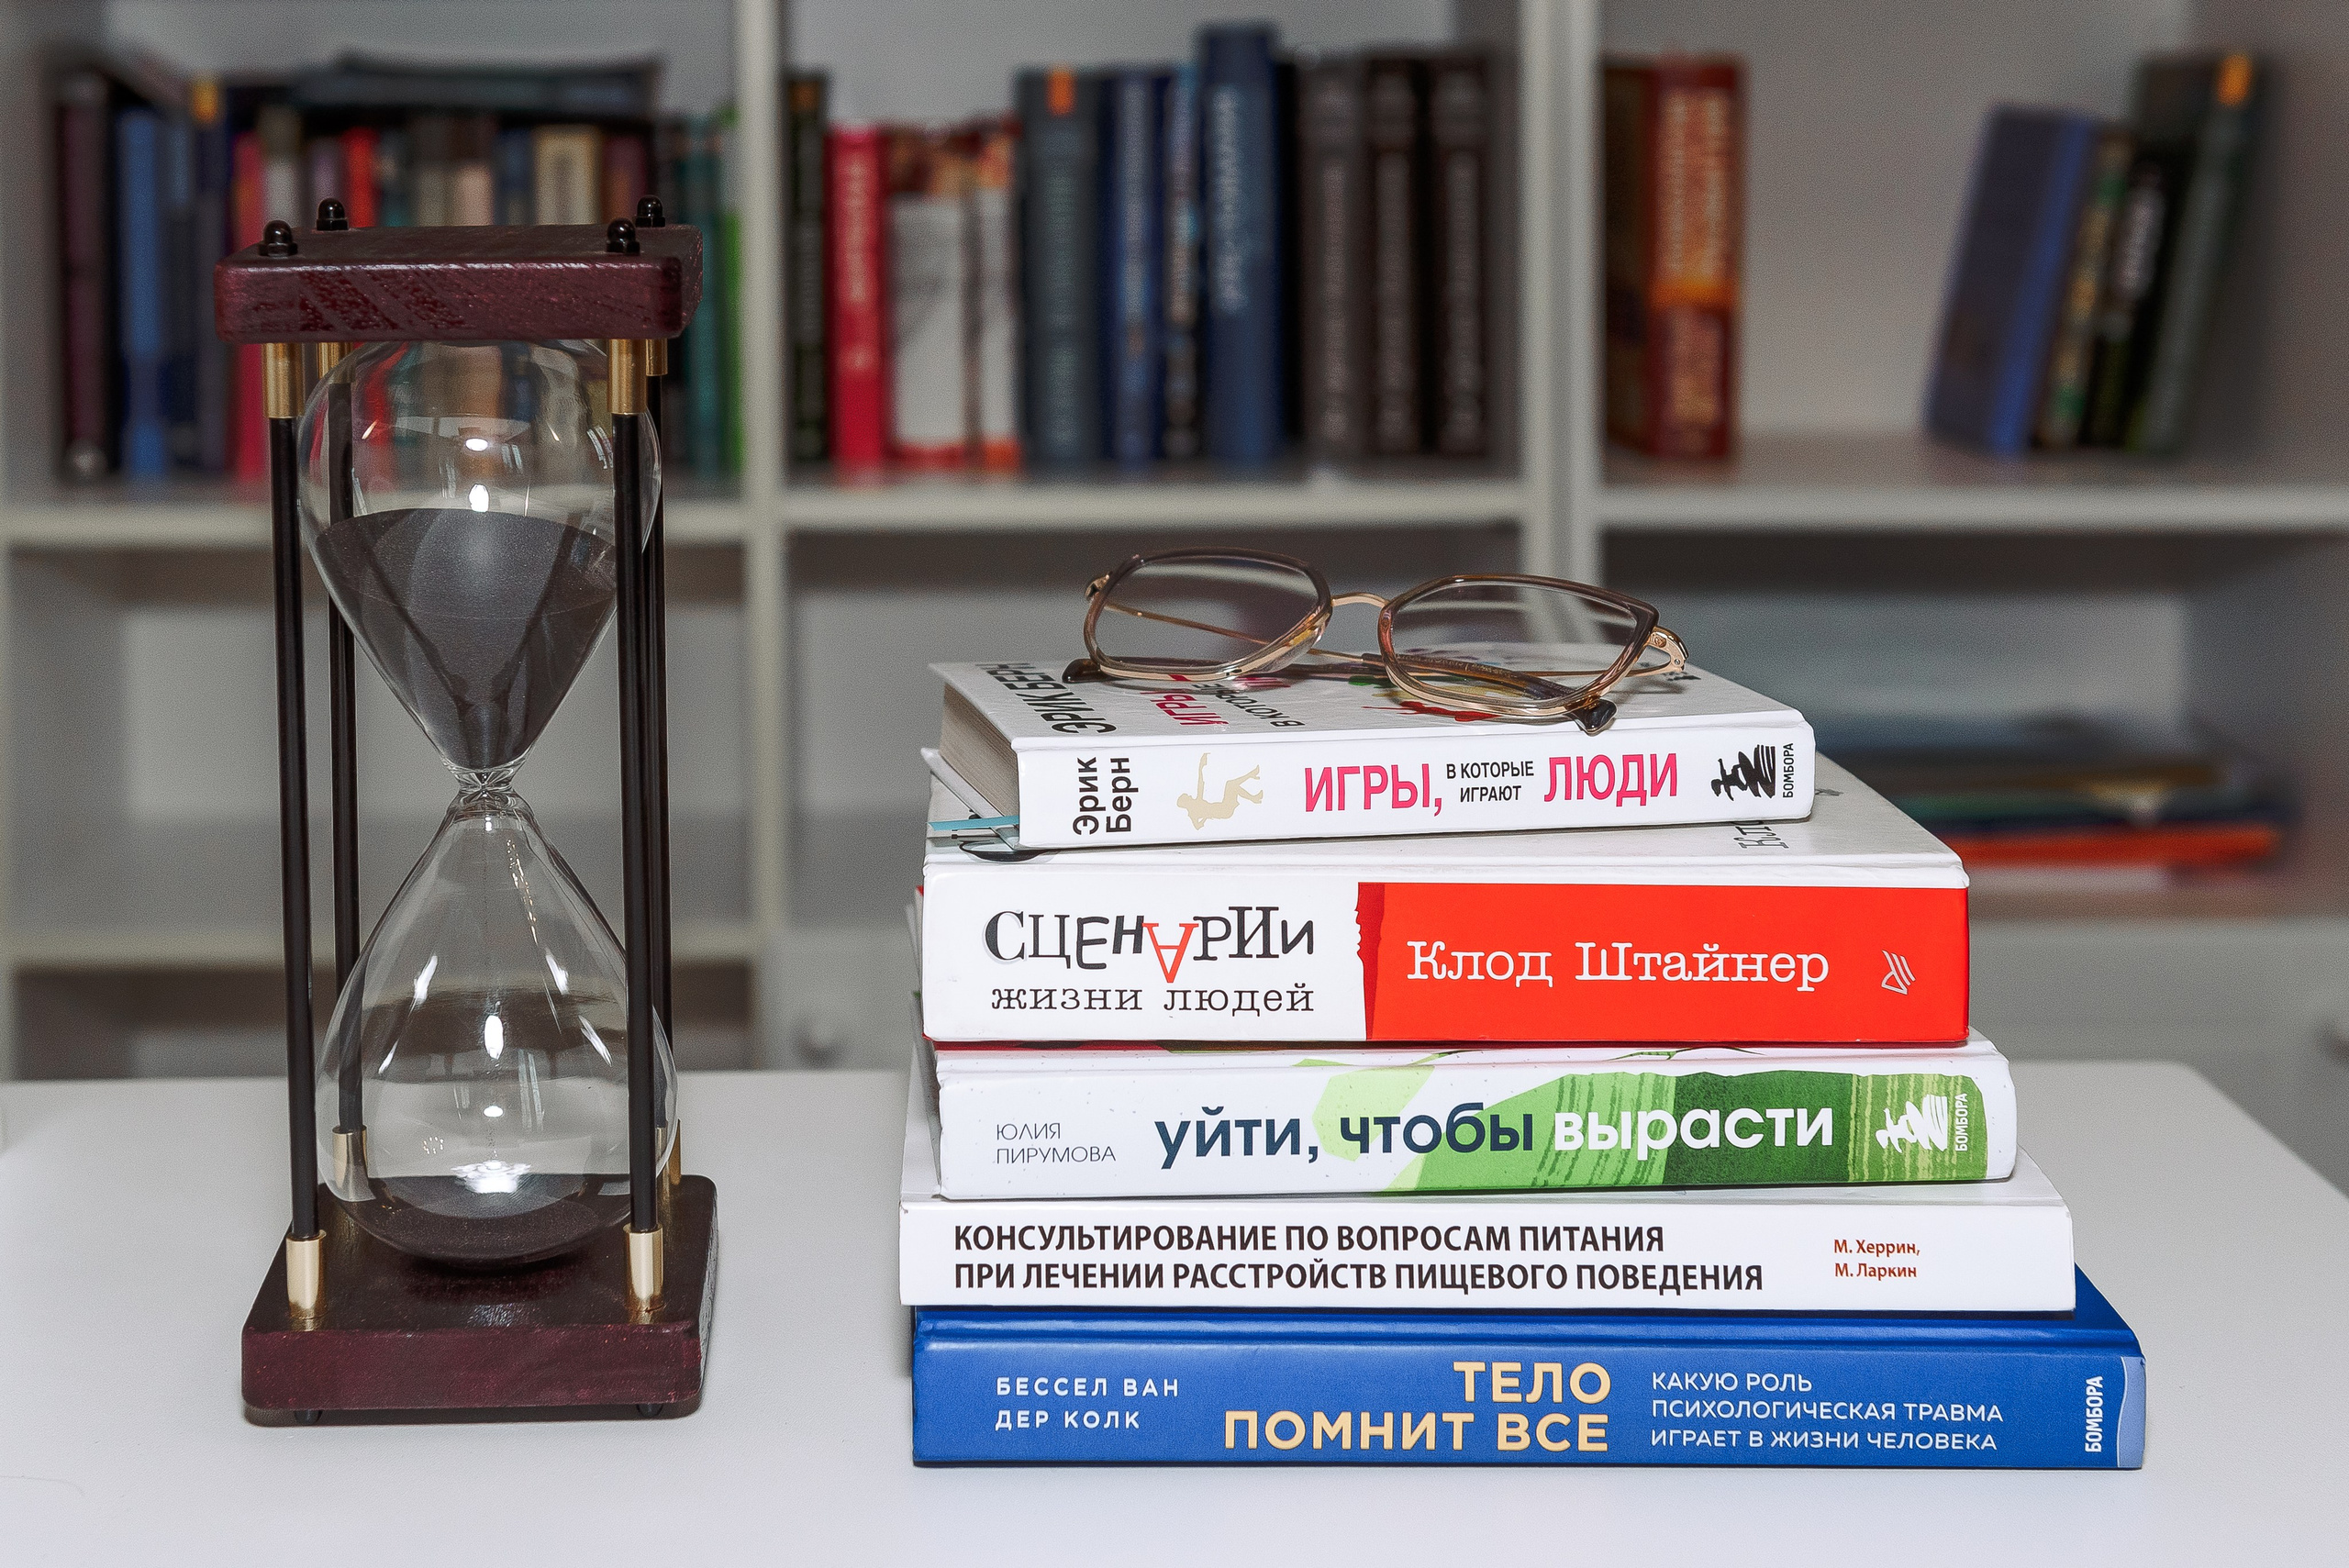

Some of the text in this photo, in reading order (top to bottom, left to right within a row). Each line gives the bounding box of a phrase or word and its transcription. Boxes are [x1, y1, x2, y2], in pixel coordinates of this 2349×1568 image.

[974, 662, 1117, 733] ЭРИК БЕРН
[1447, 761, 1534, 779] В КОТОРЫЕ
[1544, 753, 1677, 806] ЛЮДИ
[1783, 743, 1794, 797] БОМБОРА
[1073, 757, 1107, 835] Эрик
[1105, 758, 1139, 833] Берн
[1305, 763, 1444, 817] ИГРЫ,
[1461, 785, 1521, 802] ИГРАЮТ
[1407, 941, 1829, 991] Клод Штайнер
[992, 983, 1314, 1017] жизни людей
[997, 1123, 1060, 1140] ЮЛИЯ
[1154, 1101, 1833, 1169] уйти, чтобы вырасти
[1954, 1093, 1969, 1152] БОМБОРА
[997, 1146, 1116, 1163] ПИРУМОВА
[955, 1226, 1663, 1251] КОНСУЛЬТИРОВАНИЕ ПО ВОПРОСАМ ПИТАНИЯ
[1834, 1240, 1920, 1257] М. Херрин,
[956, 1259, 1762, 1296] ПРИ ЛЕЧЕНИИ РАССТРОЙСТВ ПИЩЕВОГО ПОВЕДЕНИЯ
[1835, 1263, 1916, 1281] М. Ларкин
[997, 1377, 1177, 1396] БЕССЕЛ ВАН
[1453, 1362, 1611, 1405] ТЕЛО
[1653, 1373, 1811, 1391] КАКУЮ РОЛЬ
[996, 1410, 1139, 1430] ДЕР КОЛК
[1653, 1400, 2003, 1421] ПСИХОЛОГИЧЕСКАЯ ТРАВМА
[2085, 1376, 2103, 1451] БОМБОРА
[1226, 1411, 1609, 1451] ПОМНИТ ВСЕ
[1652, 1429, 1997, 1450] ИГРАЕТ В ЖИЗНИ ЧЕЛОВЕКА
